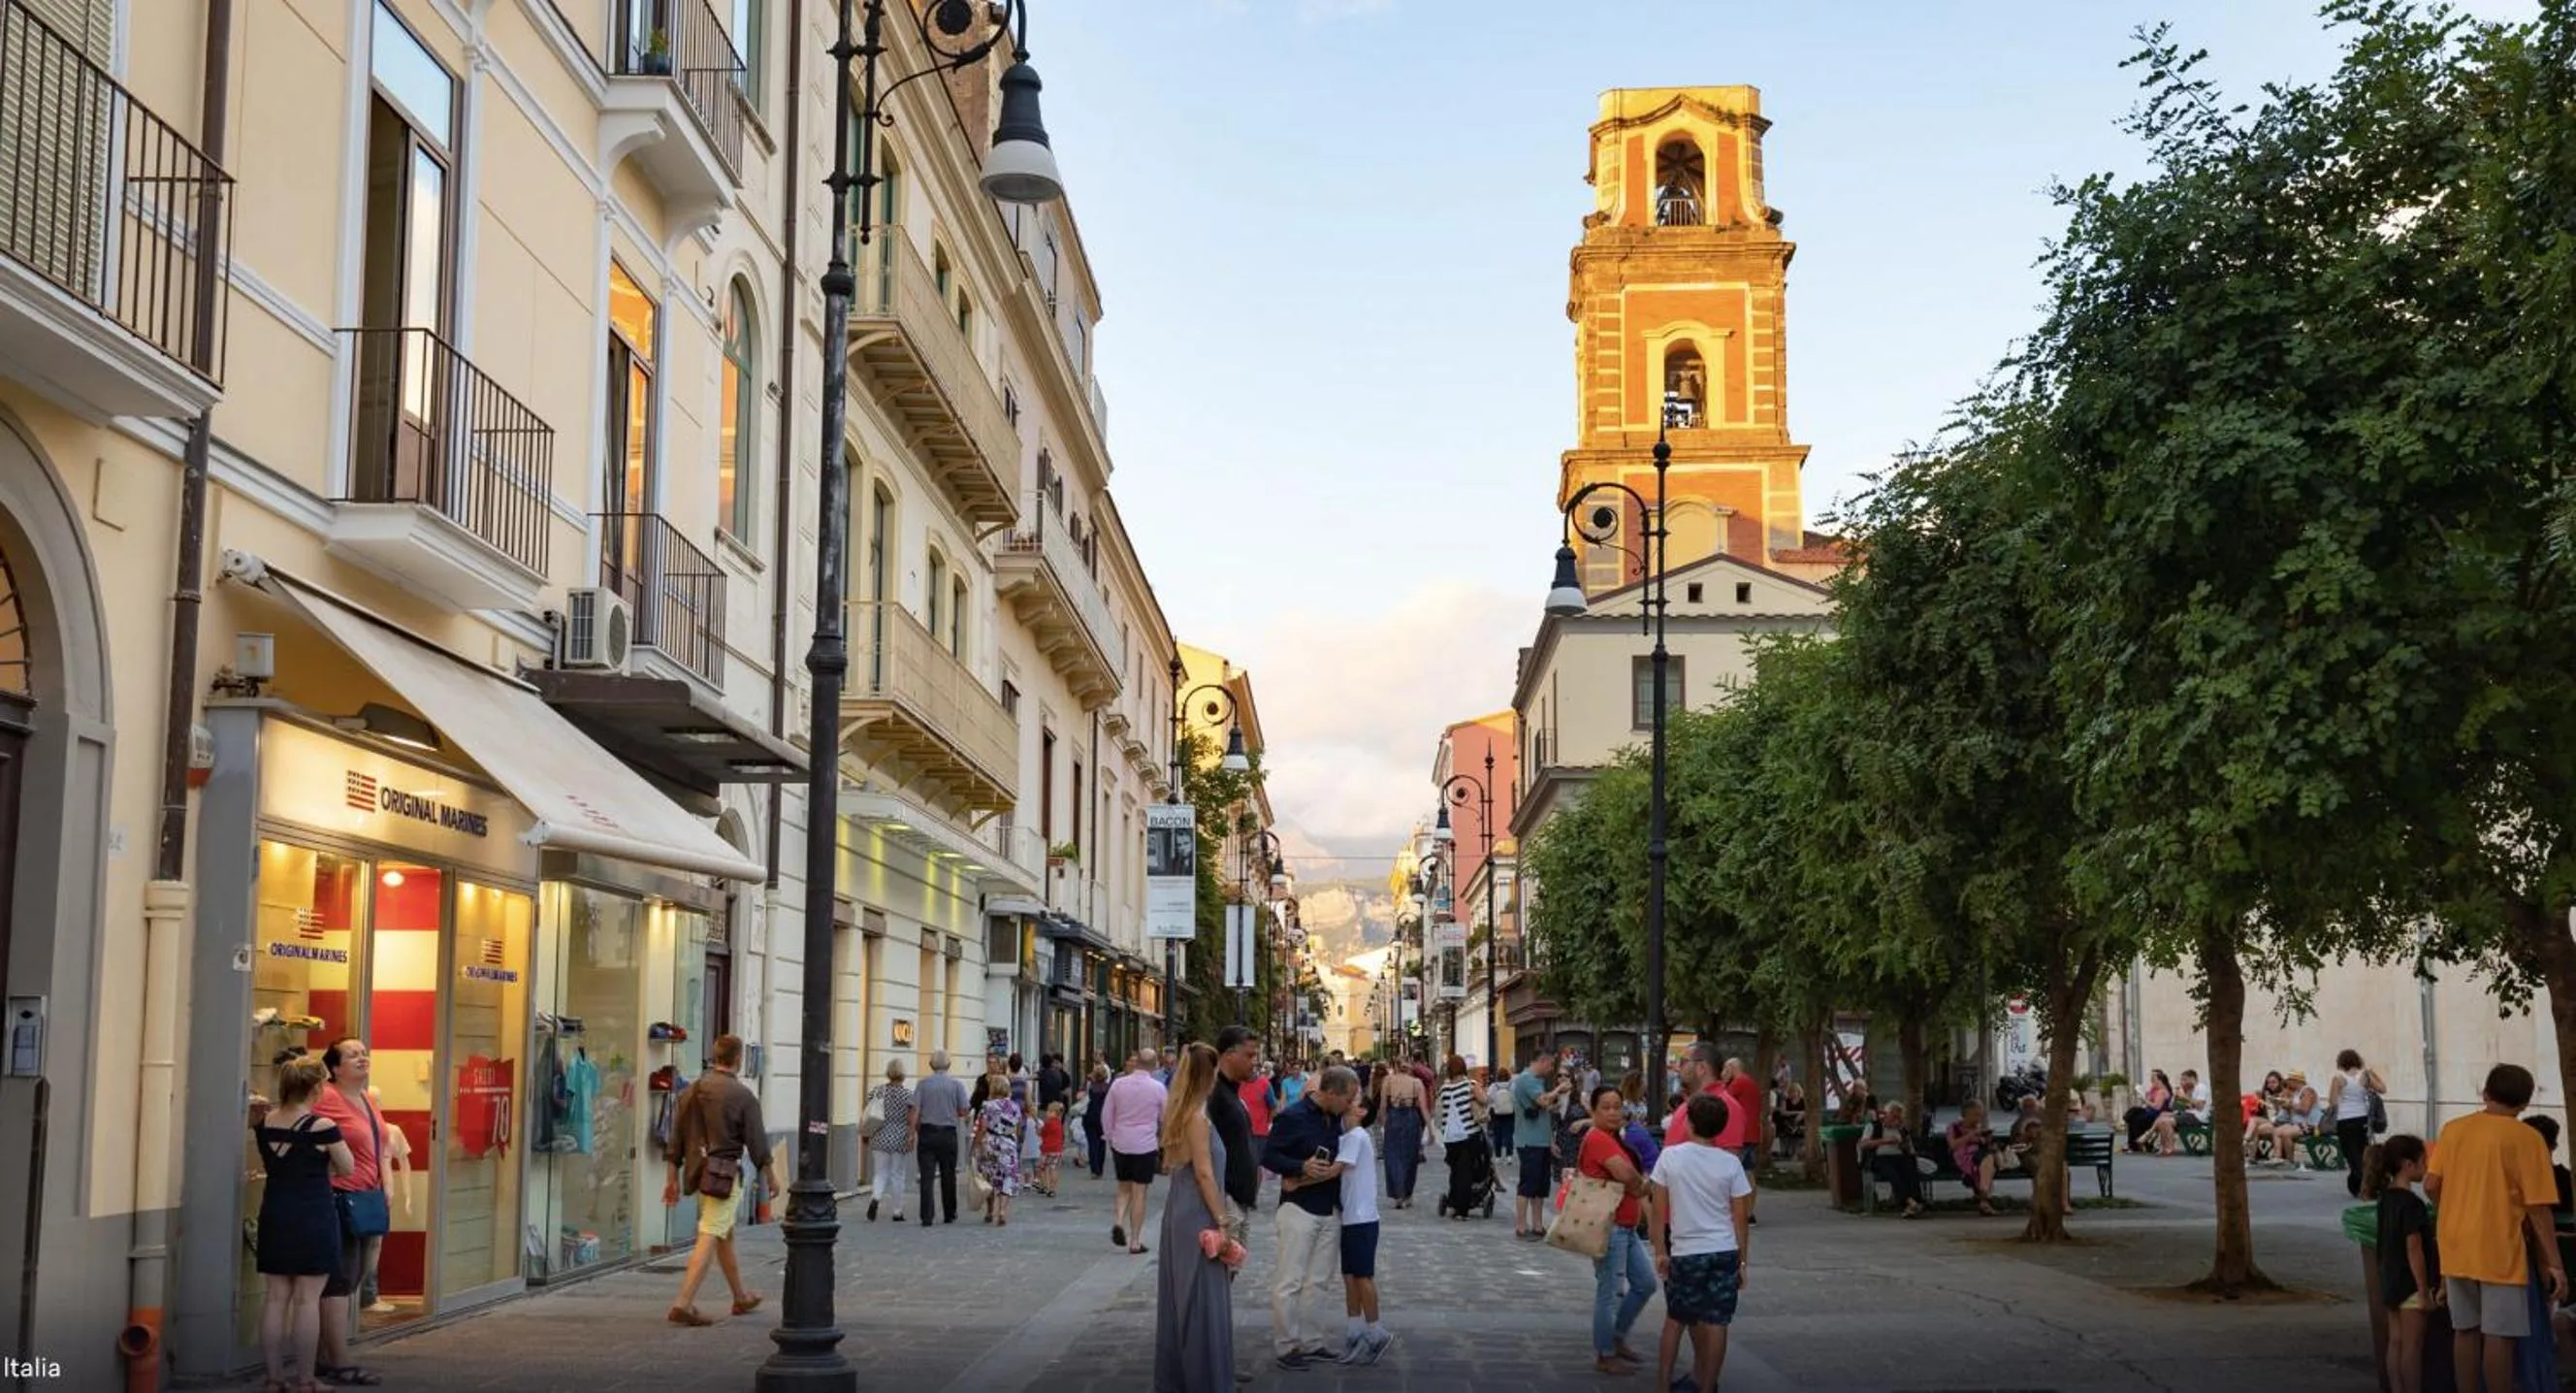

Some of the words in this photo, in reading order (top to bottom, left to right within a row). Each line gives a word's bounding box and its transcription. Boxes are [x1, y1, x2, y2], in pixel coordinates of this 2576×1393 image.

[380, 786, 437, 825] ORIGINAL
[439, 803, 489, 838] MARINES
[1150, 816, 1191, 826] BACON
